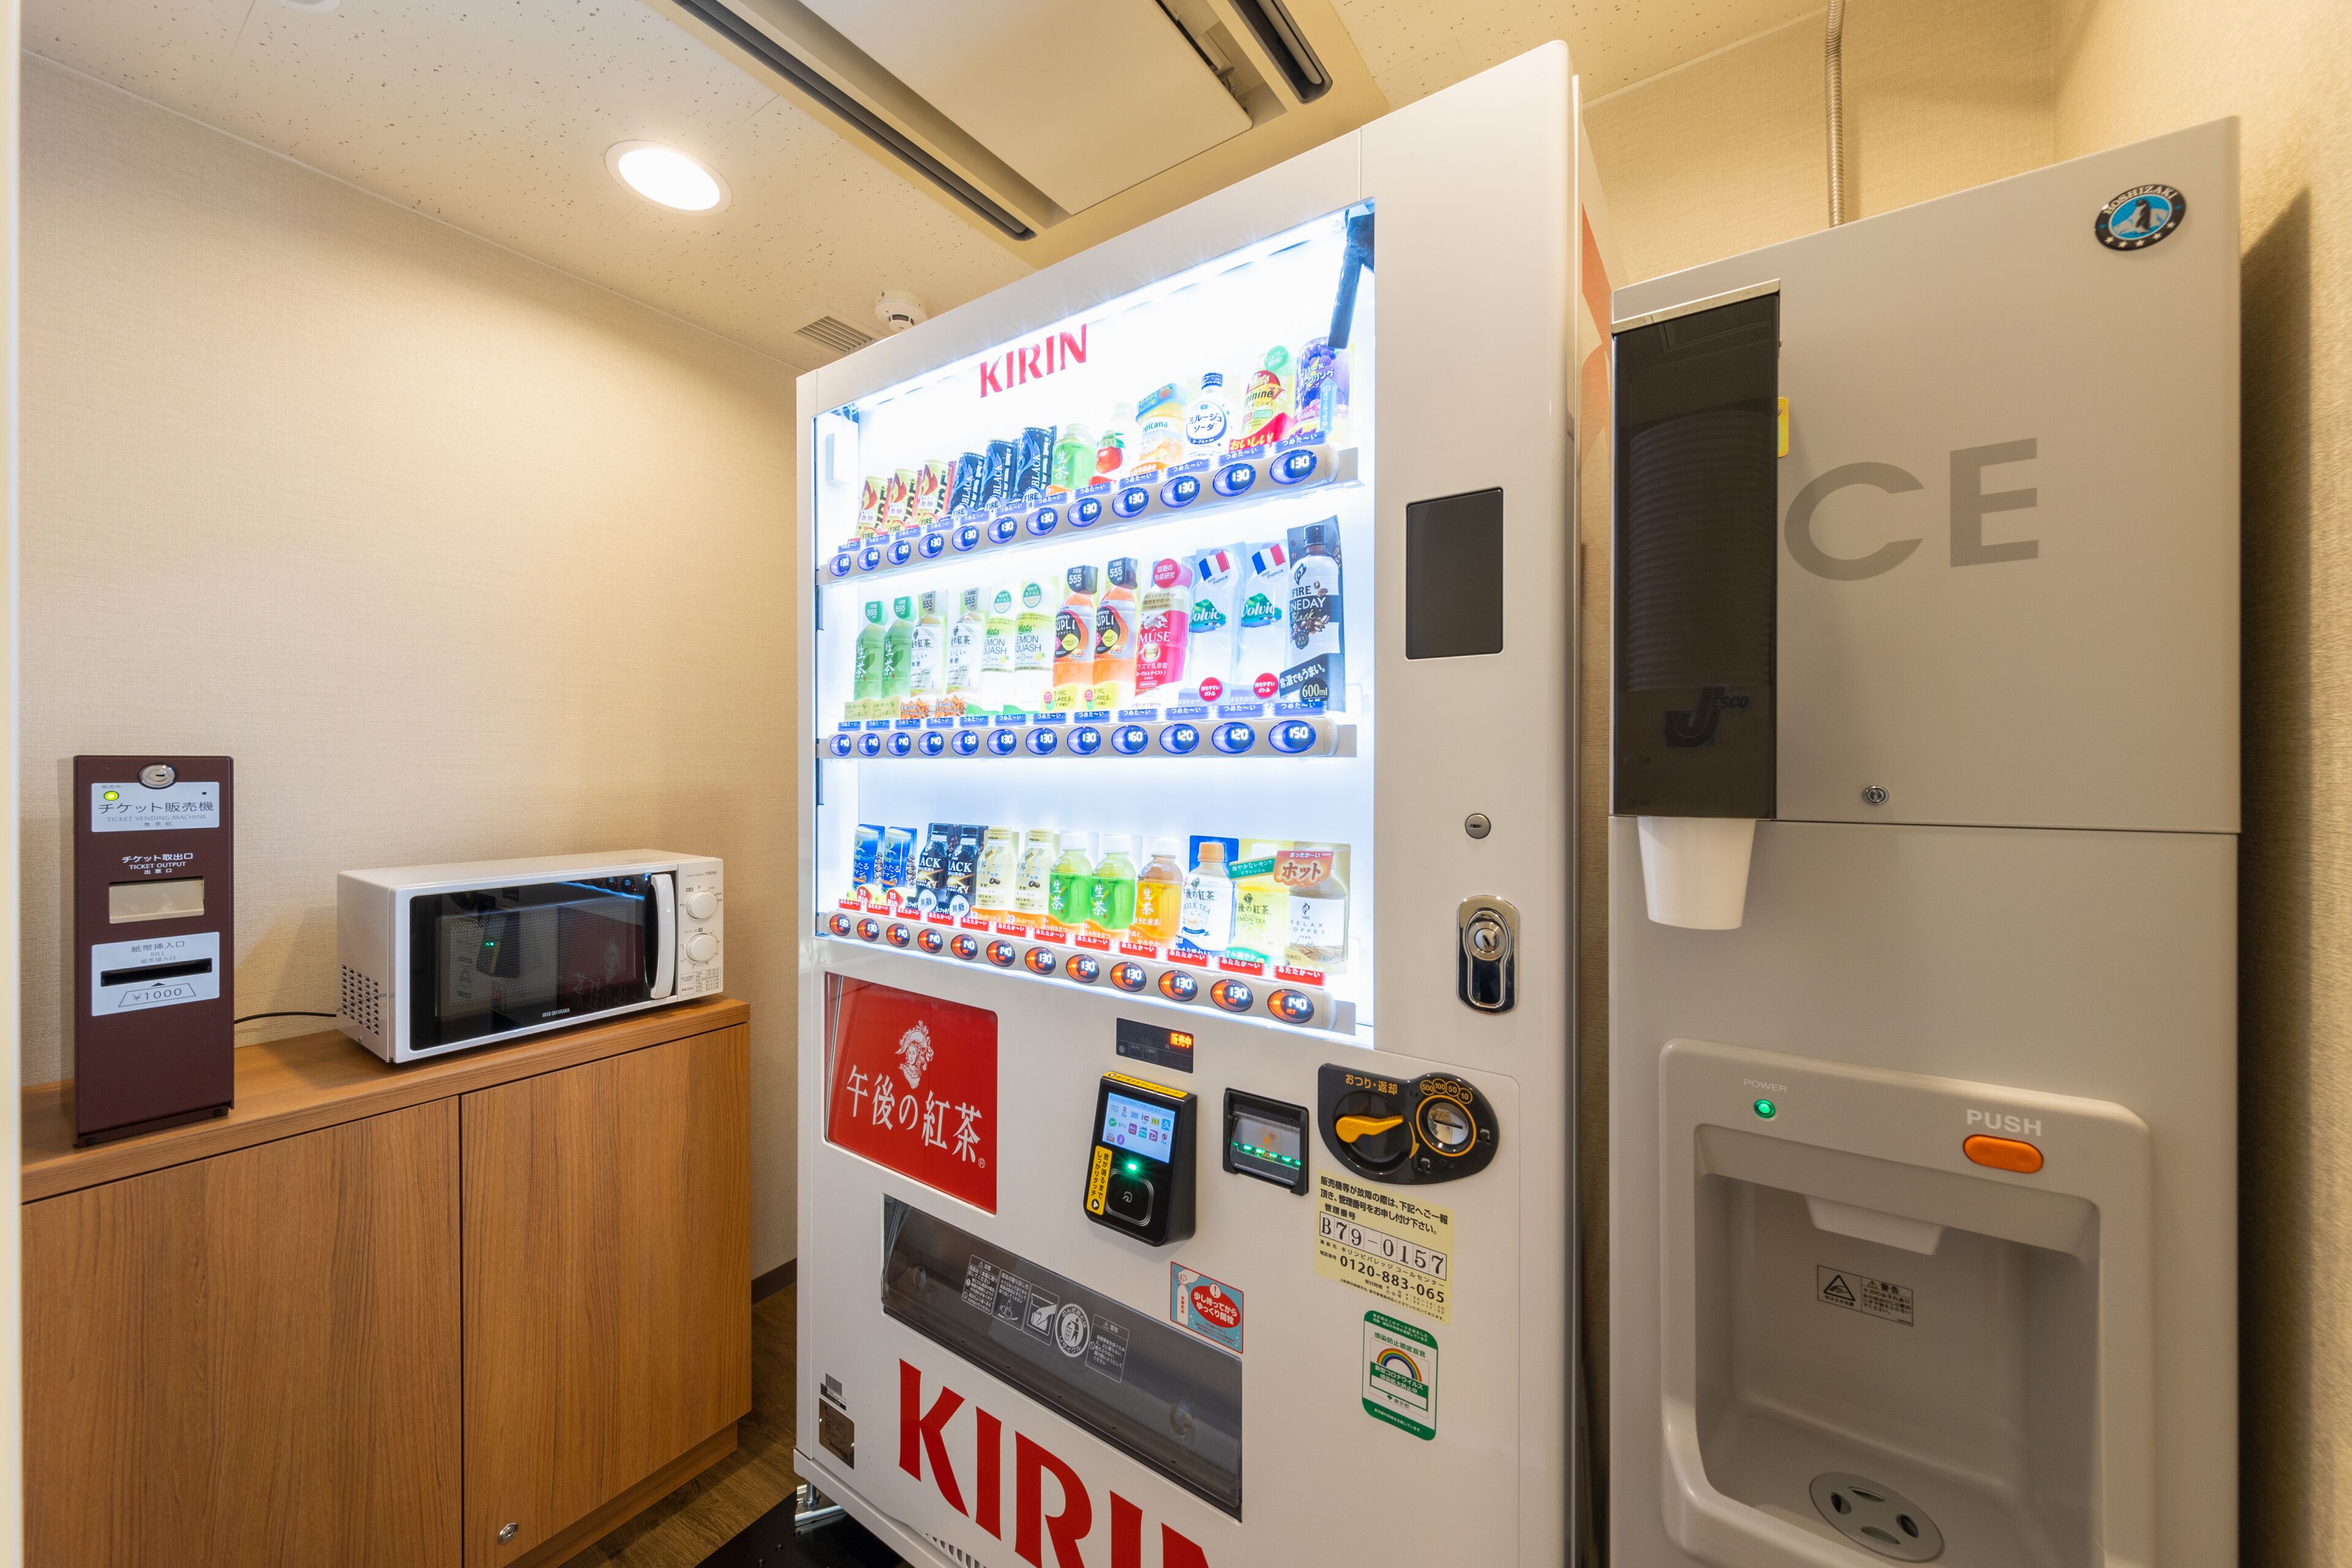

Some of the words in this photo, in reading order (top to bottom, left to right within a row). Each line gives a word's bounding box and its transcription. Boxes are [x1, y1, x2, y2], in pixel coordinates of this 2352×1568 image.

[2103, 185, 2179, 214] HOSHIZAKI
[980, 323, 1087, 398] KIRIN
[1189, 412, 1223, 424] ミルージュ
[1194, 421, 1217, 433] ソーダ
[1055, 449, 1069, 480] 生茶
[1290, 455, 1310, 469] 130
[1031, 453, 1041, 487] BLACK
[1232, 469, 1250, 482] 130
[993, 464, 1003, 495] BLACK
[961, 475, 973, 505] BLACK
[1178, 481, 1194, 494] 130
[1025, 492, 1039, 502] FIRE
[1128, 492, 1144, 504] 130
[986, 500, 998, 510] FIRE
[1083, 502, 1098, 514] 130
[1784, 437, 2040, 581] CE
[1041, 512, 1054, 524] 130
[1001, 521, 1014, 532] 130
[965, 529, 977, 540] 130
[930, 537, 941, 547] 130
[869, 551, 878, 560] 130
[899, 545, 909, 554] 130
[840, 557, 850, 567] 130
[1157, 564, 1173, 573] 話題の
[1068, 573, 1082, 584] 555
[1109, 567, 1123, 578] 555
[1153, 571, 1175, 582] 免疫研究
[1267, 568, 1284, 579] France
[1212, 575, 1229, 586] France
[1292, 586, 1312, 597] FIRE
[922, 599, 933, 609] 555
[964, 595, 976, 605] 555
[1289, 597, 1327, 611] NEDAY
[867, 608, 877, 617] 555
[895, 605, 906, 613] 555
[855, 644, 867, 678] 生茶
[884, 641, 895, 676] 生茶
[1279, 663, 1326, 689] 常温でもうまい。
[1200, 684, 1221, 693] 持ちやすい
[1254, 680, 1276, 690] 持ちやすい
[1302, 683, 1329, 698] 600ml
[1177, 729, 1194, 741] 120
[1231, 728, 1249, 740] 120
[1289, 727, 1308, 739] 150
[840, 737, 850, 747] 140
[869, 737, 879, 747] 140
[930, 736, 941, 745] 140
[98, 801, 214, 815] チケット販売機
[121, 853, 194, 863] チケット取出口
[918, 856, 942, 868] ACK
[1282, 861, 1322, 881] ホット
[919, 896, 933, 907] 無糖
[1051, 880, 1065, 911] 生茶
[1092, 883, 1107, 916] 生茶
[1141, 887, 1155, 916] 生茶
[951, 902, 965, 913] 無糖
[1199, 903, 1212, 916] TEA
[1237, 902, 1271, 916] 後の紅茶
[1254, 916, 1267, 925] TEA
[897, 929, 908, 938] 140
[1292, 927, 1325, 935] OFFEE
[929, 935, 940, 943] 140
[963, 940, 975, 950] 140
[130, 940, 186, 953] 紙幣挿入口
[999, 947, 1012, 957] 140
[1175, 976, 1193, 990] 130
[132, 987, 183, 1001] ¥1000
[1288, 997, 1308, 1011] 140
[1170, 1032, 1193, 1049] 販売中
[1345, 1073, 1398, 1096] おつり・返却
[1743, 1079, 1788, 1093] POWER
[1422, 1083, 1434, 1092] 500
[1434, 1082, 1446, 1091] 100
[1448, 1085, 1457, 1094] 50
[1460, 1092, 1469, 1101] 10
[846, 1064, 982, 1163] 午後の紅茶
[1966, 1109, 2043, 1137] PUSH
[1091, 1150, 1102, 1197] しっかりタッチ
[1098, 1153, 1109, 1200] 音が鳴るまで
[1321, 1175, 1449, 1225] 販売機等が故障の際は、下記へご一報
[1320, 1188, 1437, 1235] 頂き、管理番号をお申し付け下さい。
[1324, 1203, 1356, 1220] 管理番号
[1320, 1239, 1338, 1250] 連絡先
[1396, 1266, 1445, 1287] コールセンター
[1319, 1250, 1337, 1261] 電話番号
[1340, 1255, 1445, 1303] 0120-883-065
[1364, 1278, 1383, 1290] 受付時間
[1880, 1283, 1899, 1295] 警告
[1863, 1287, 1910, 1305] ケガのおそれあり
[1193, 1291, 1238, 1317] 少し待ってから
[1061, 1307, 1088, 1329] のんだあとは
[1196, 1301, 1235, 1325] ゆっくり開栓
[1058, 1335, 1082, 1354] リサイクル
[1374, 1332, 1427, 1359] 感染防止徹底宣言
[1374, 1364, 1424, 1390] 新型コロナウイルス
[1379, 1373, 1419, 1395] 感染拡大防止中
